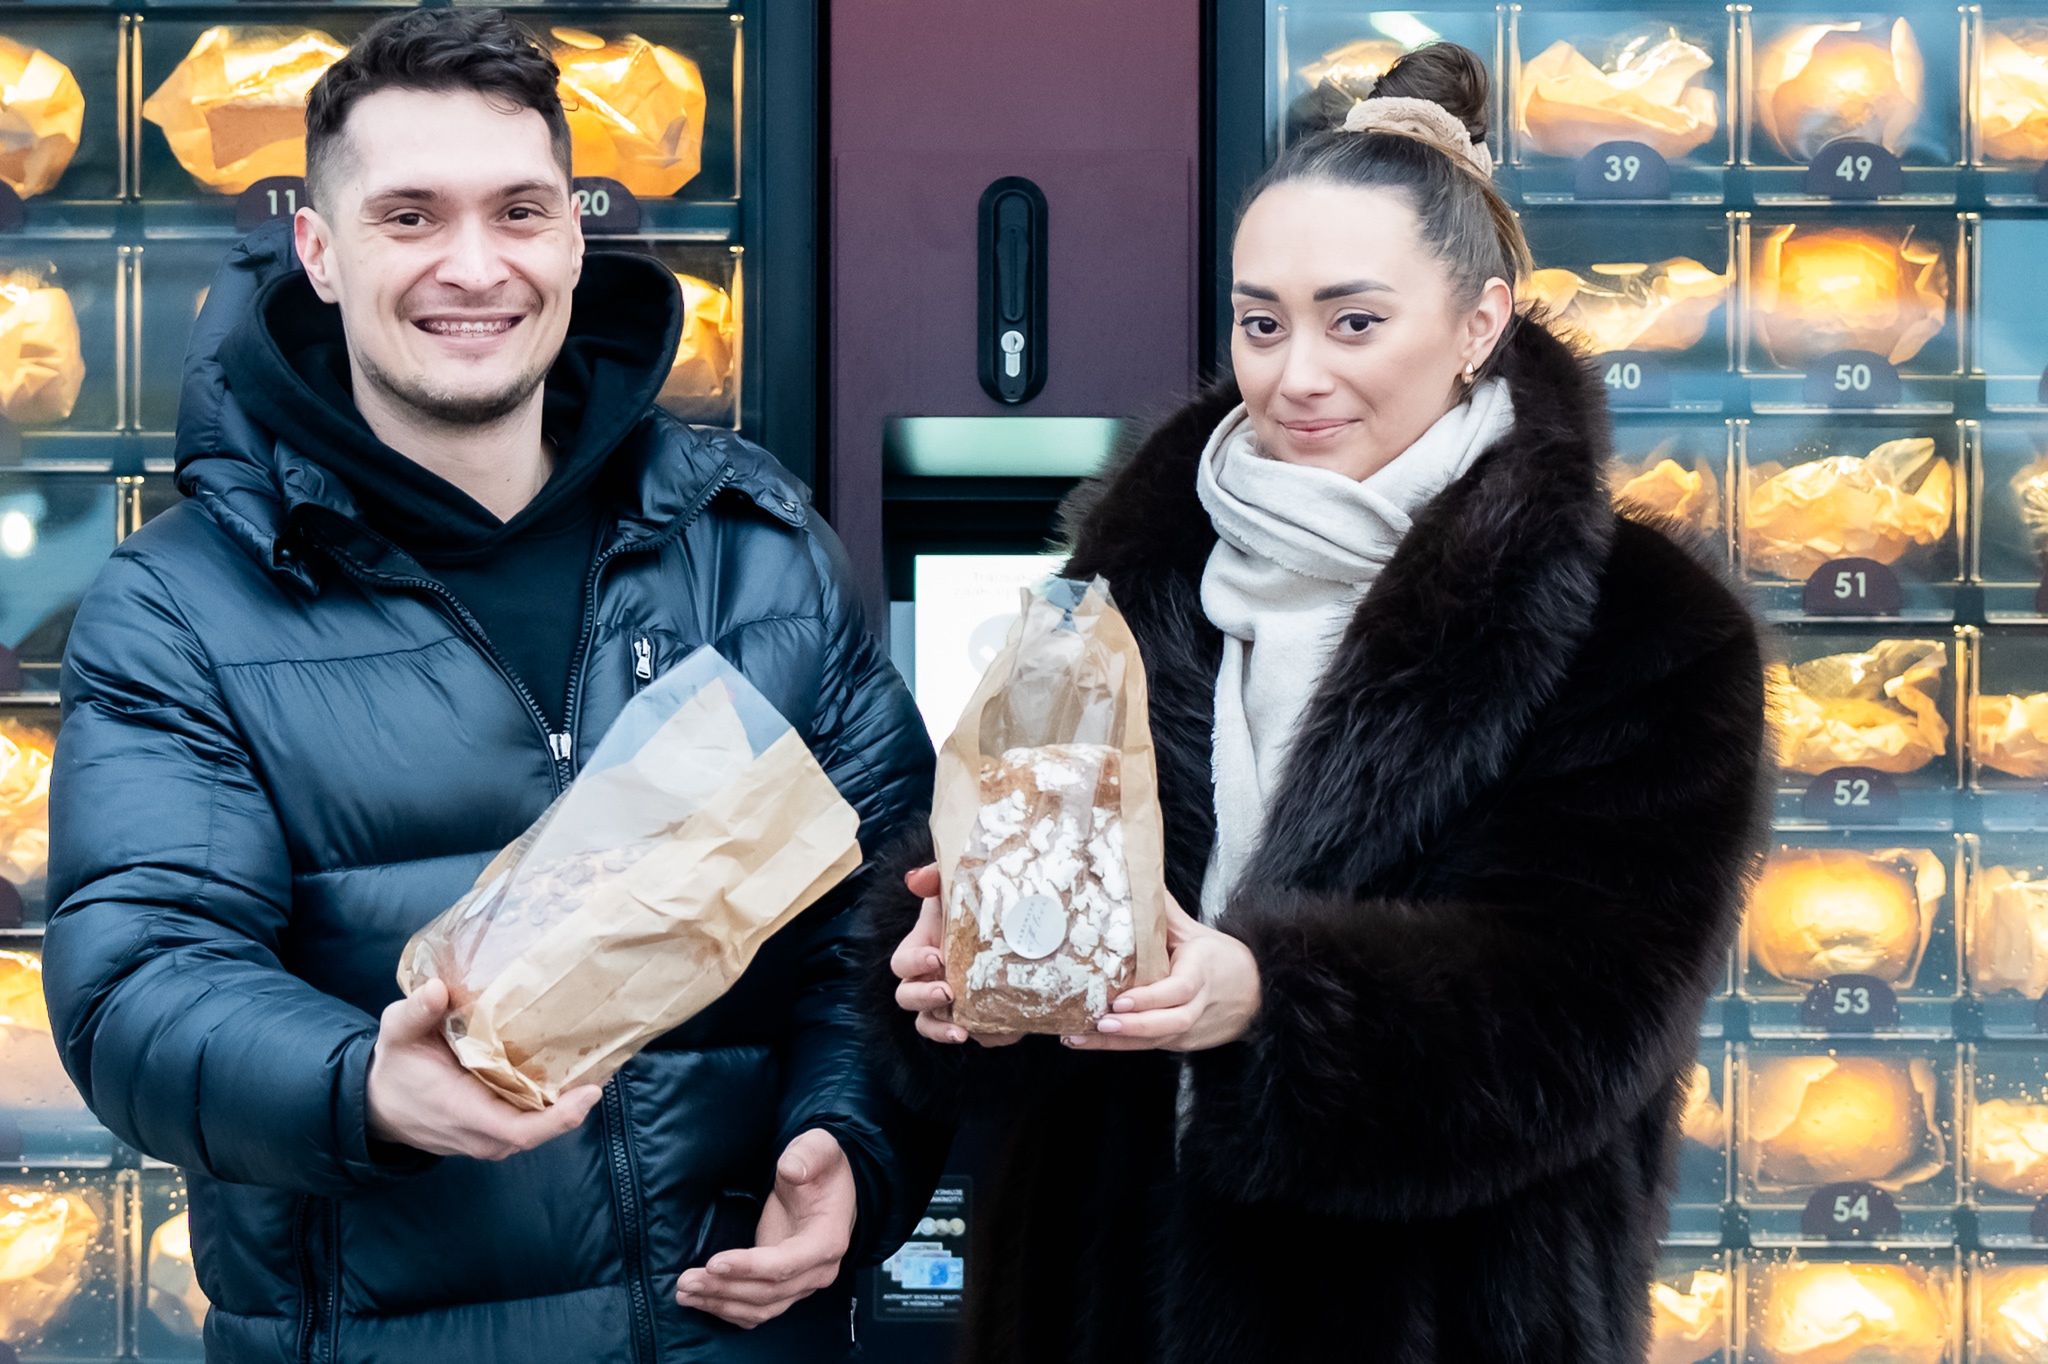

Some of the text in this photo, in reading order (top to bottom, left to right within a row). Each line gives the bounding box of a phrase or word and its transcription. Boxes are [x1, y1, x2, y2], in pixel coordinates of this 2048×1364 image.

[1603, 155, 1640, 182] 39
[1835, 155, 1873, 182] 49
[266, 189, 296, 216] 11
[575, 189, 610, 217] 20
[1604, 362, 1642, 390] 40
[1834, 363, 1872, 391] 50
[1833, 571, 1867, 599] 51
[1833, 779, 1871, 806] 52
[1833, 987, 1870, 1015] 53
[1832, 1194, 1870, 1222] 54
